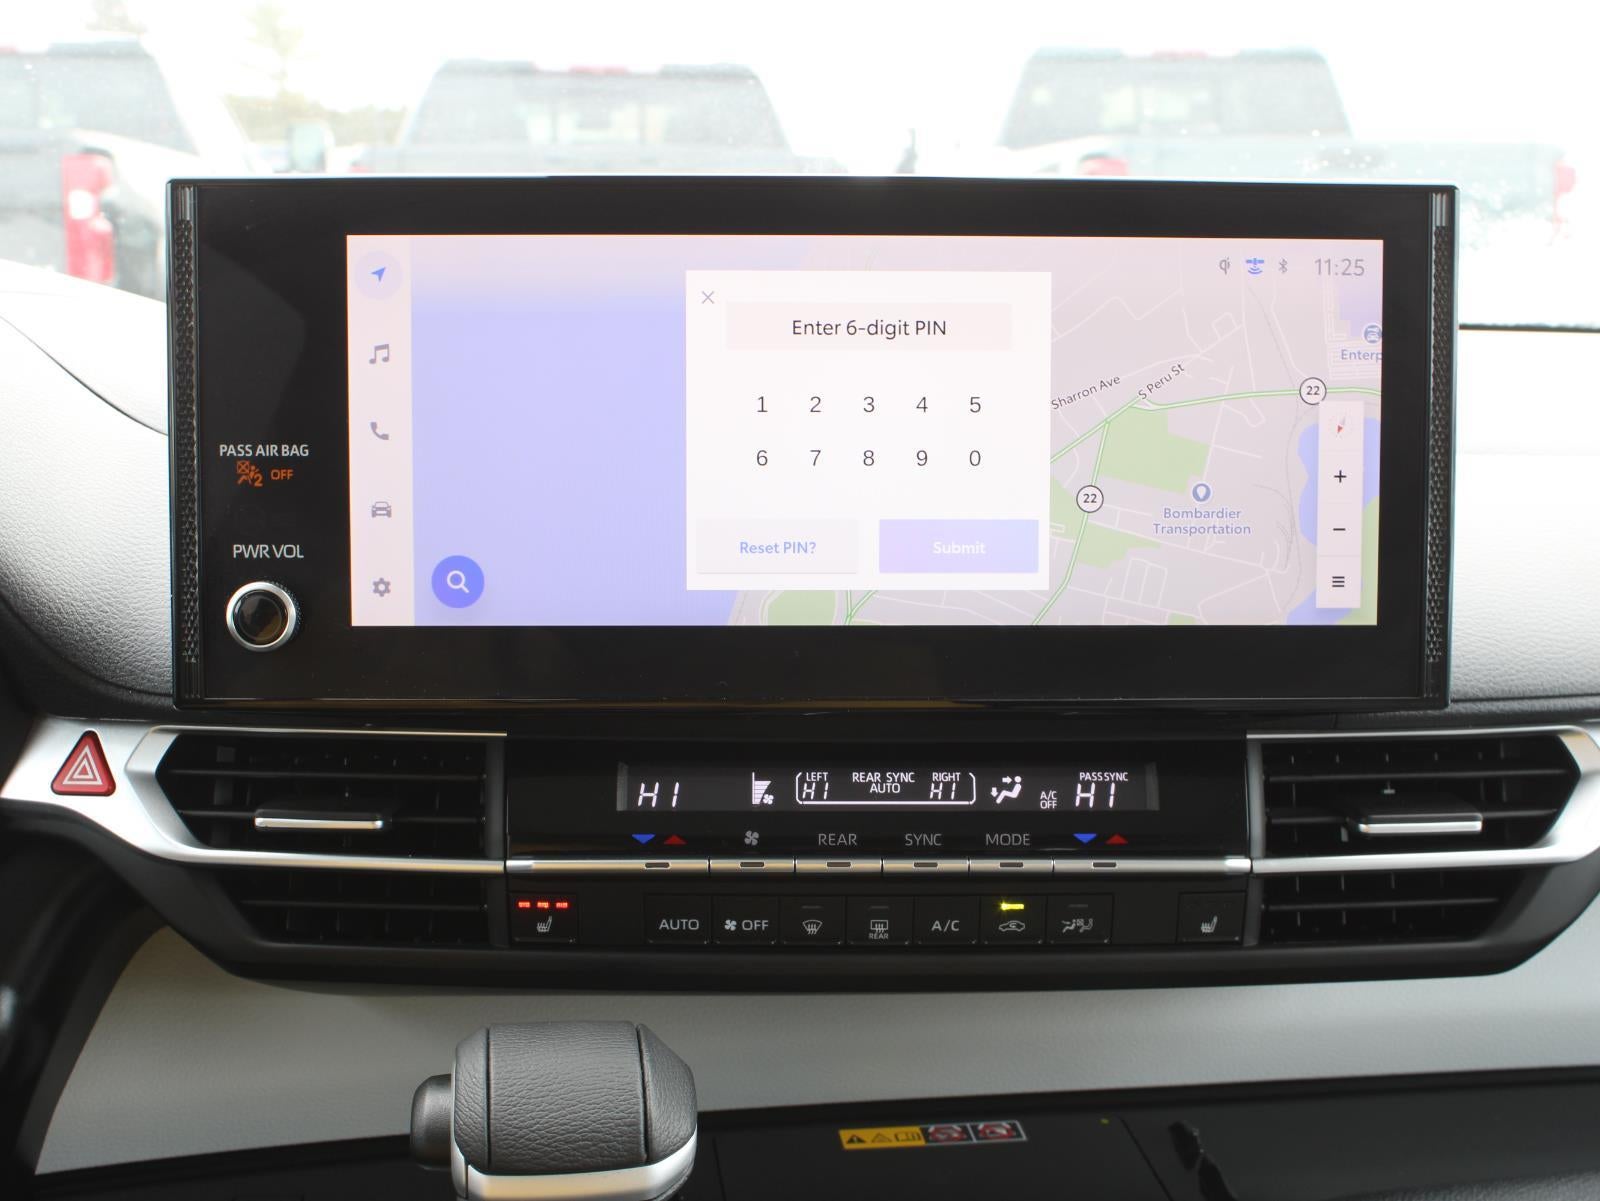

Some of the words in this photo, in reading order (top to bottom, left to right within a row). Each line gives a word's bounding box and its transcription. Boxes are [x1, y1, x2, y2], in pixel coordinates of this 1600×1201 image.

[1314, 259, 1365, 276] 11:25
[792, 320, 841, 336] Enter
[847, 319, 909, 339] 6-digit
[916, 320, 946, 335] PIN
[1137, 386, 1149, 400] S
[1147, 374, 1172, 394] Peru
[1172, 362, 1185, 376] St
[1051, 384, 1098, 410] Sharron
[1098, 375, 1121, 391] Ave
[1306, 386, 1320, 396] 22
[756, 396, 768, 413] 1
[810, 396, 821, 413] 2
[863, 396, 875, 413] 3
[916, 396, 928, 413] 4
[969, 396, 981, 413] 5
[220, 444, 252, 457] PASS
[256, 444, 279, 457] AIR
[281, 444, 309, 457] BAG
[756, 450, 768, 467] 6
[810, 450, 821, 467] 7
[863, 450, 875, 467] 8
[916, 450, 928, 467] 9
[969, 450, 981, 467] 0
[271, 469, 293, 480] OFF
[1083, 494, 1097, 504] 22
[1164, 507, 1241, 520] Bombardier
[1154, 523, 1251, 536] Transportation
[233, 544, 269, 559] PWR
[272, 544, 304, 559] VOL
[740, 541, 779, 554] Reset
[783, 541, 816, 554] PIN?
[933, 541, 986, 554] Submit
[806, 772, 828, 781] LEFT
[852, 772, 881, 783] REAR
[887, 772, 915, 783] SYNC
[933, 772, 960, 782] RIGHT
[1080, 772, 1103, 781] PASS
[1104, 772, 1128, 781] SYNC
[870, 784, 900, 794] AUTO
[1040, 791, 1057, 801] A/C
[1040, 801, 1057, 809] OFF
[818, 834, 857, 845] REAR
[905, 834, 942, 846] SYNC
[986, 834, 1030, 846] MODE
[659, 920, 699, 930] AUTO
[742, 920, 768, 930] OFF
[932, 920, 960, 932] A/C
[868, 932, 889, 940] REAR
